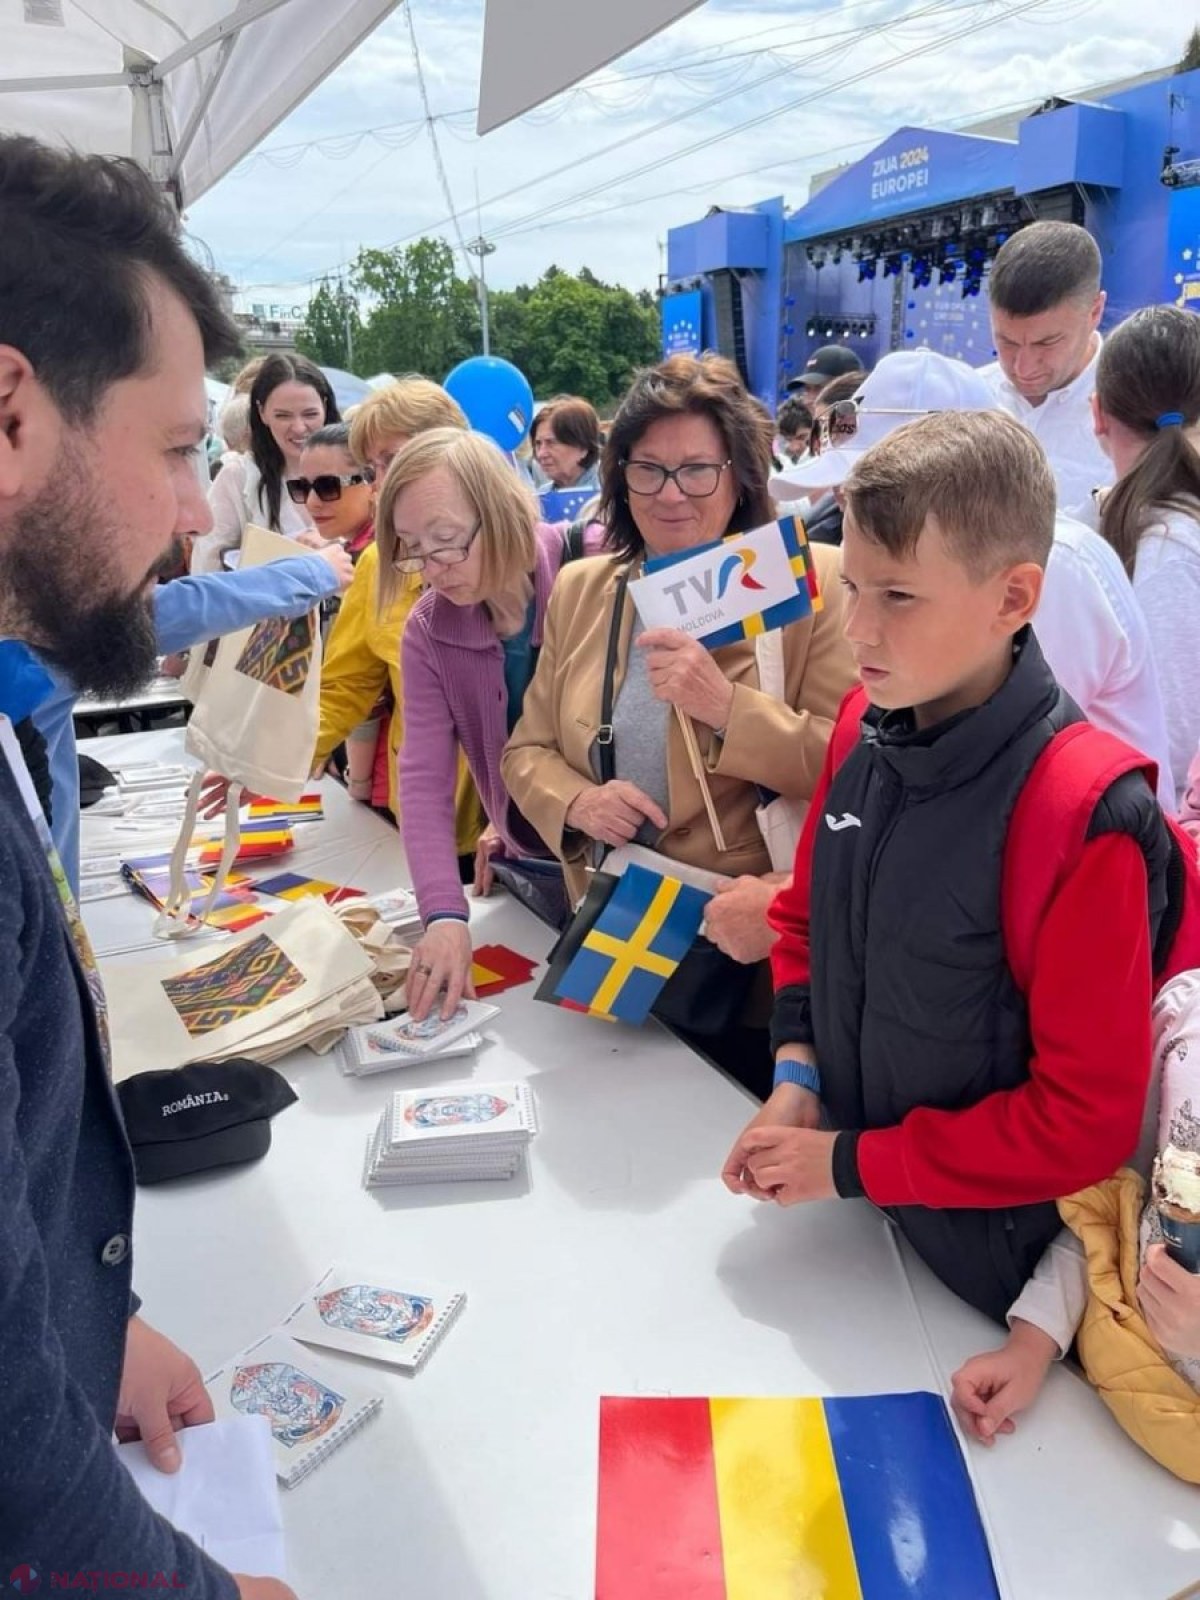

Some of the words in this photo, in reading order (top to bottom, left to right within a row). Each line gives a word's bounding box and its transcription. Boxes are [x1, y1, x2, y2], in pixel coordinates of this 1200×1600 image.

[872, 155, 898, 178] ZIUA
[900, 145, 929, 169] 2024
[871, 168, 929, 200] EUROPEI
